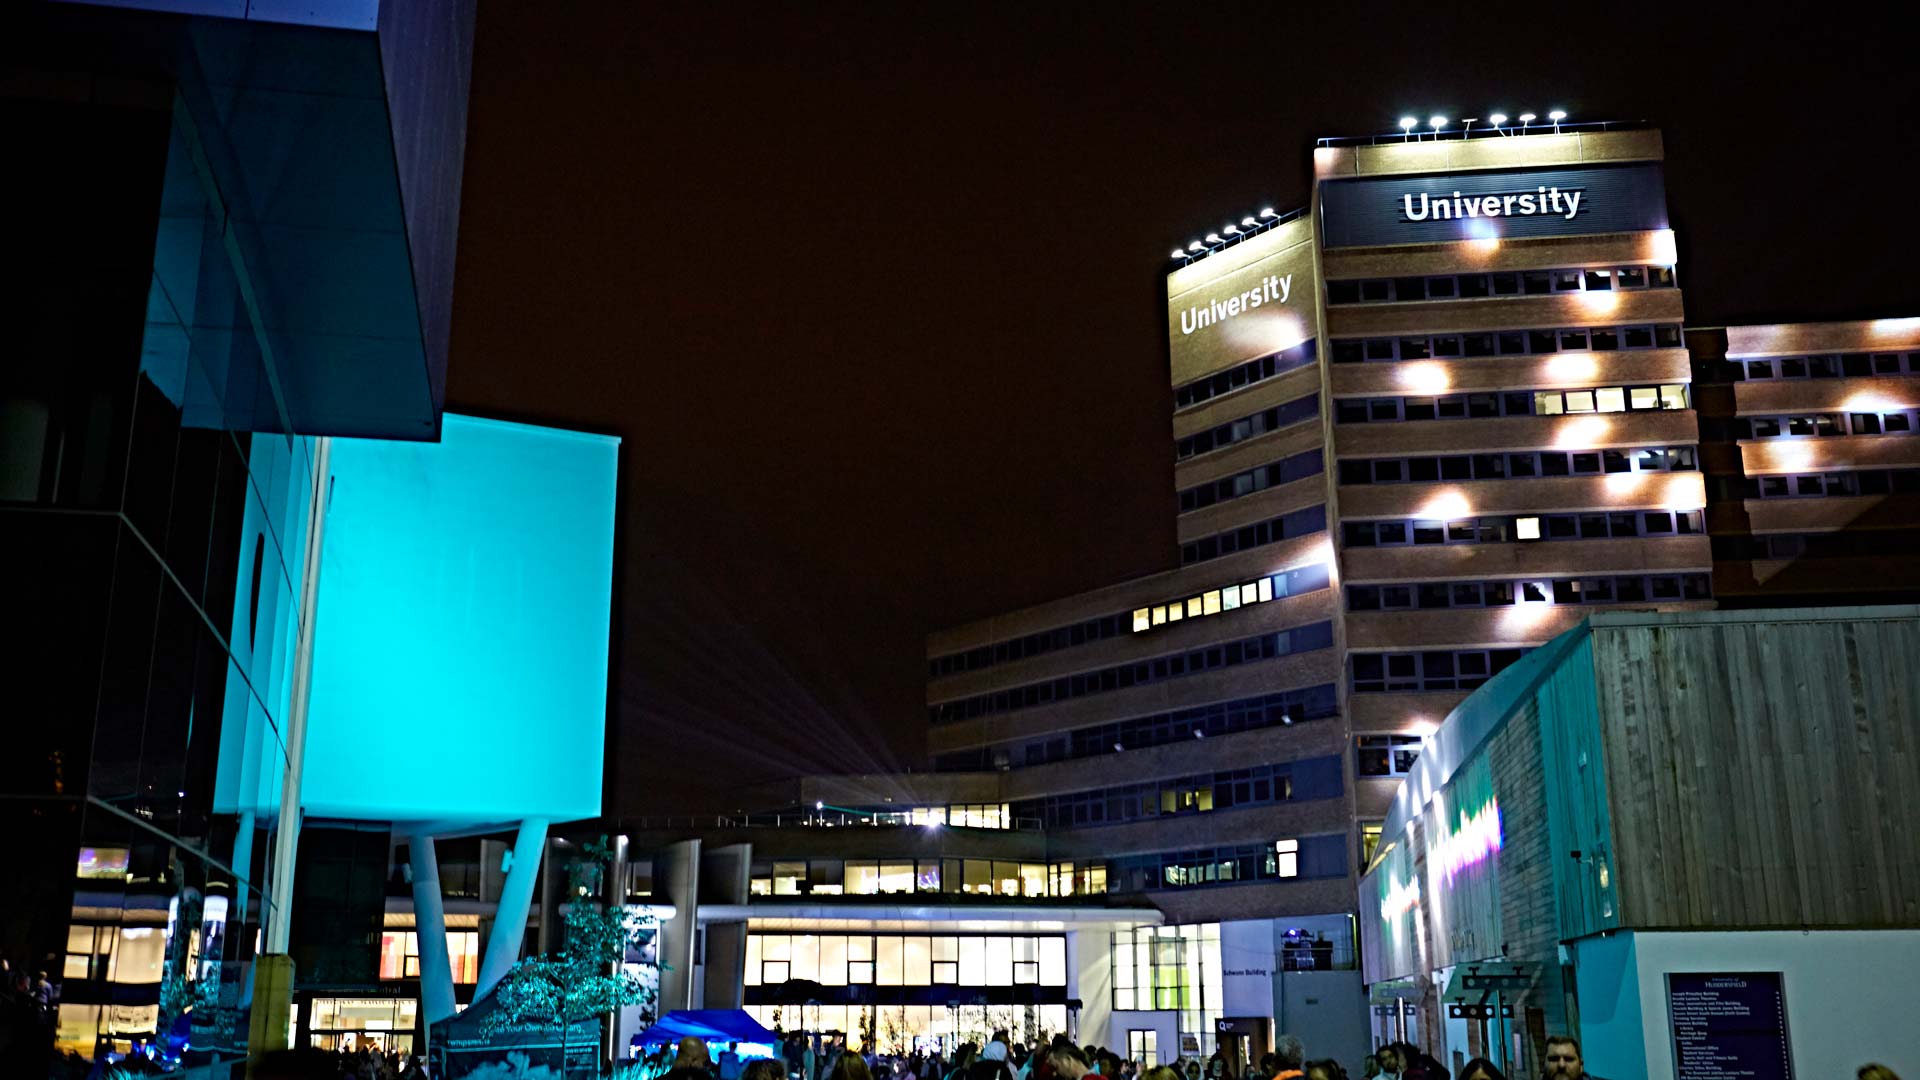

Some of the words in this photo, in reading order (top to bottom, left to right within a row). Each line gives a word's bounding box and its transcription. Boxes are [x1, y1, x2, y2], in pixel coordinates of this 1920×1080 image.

[1403, 186, 1582, 221] University
[1181, 271, 1293, 335] University
[1245, 968, 1266, 977] Building
[506, 1024, 524, 1032] Your
[524, 1022, 542, 1032] Own
